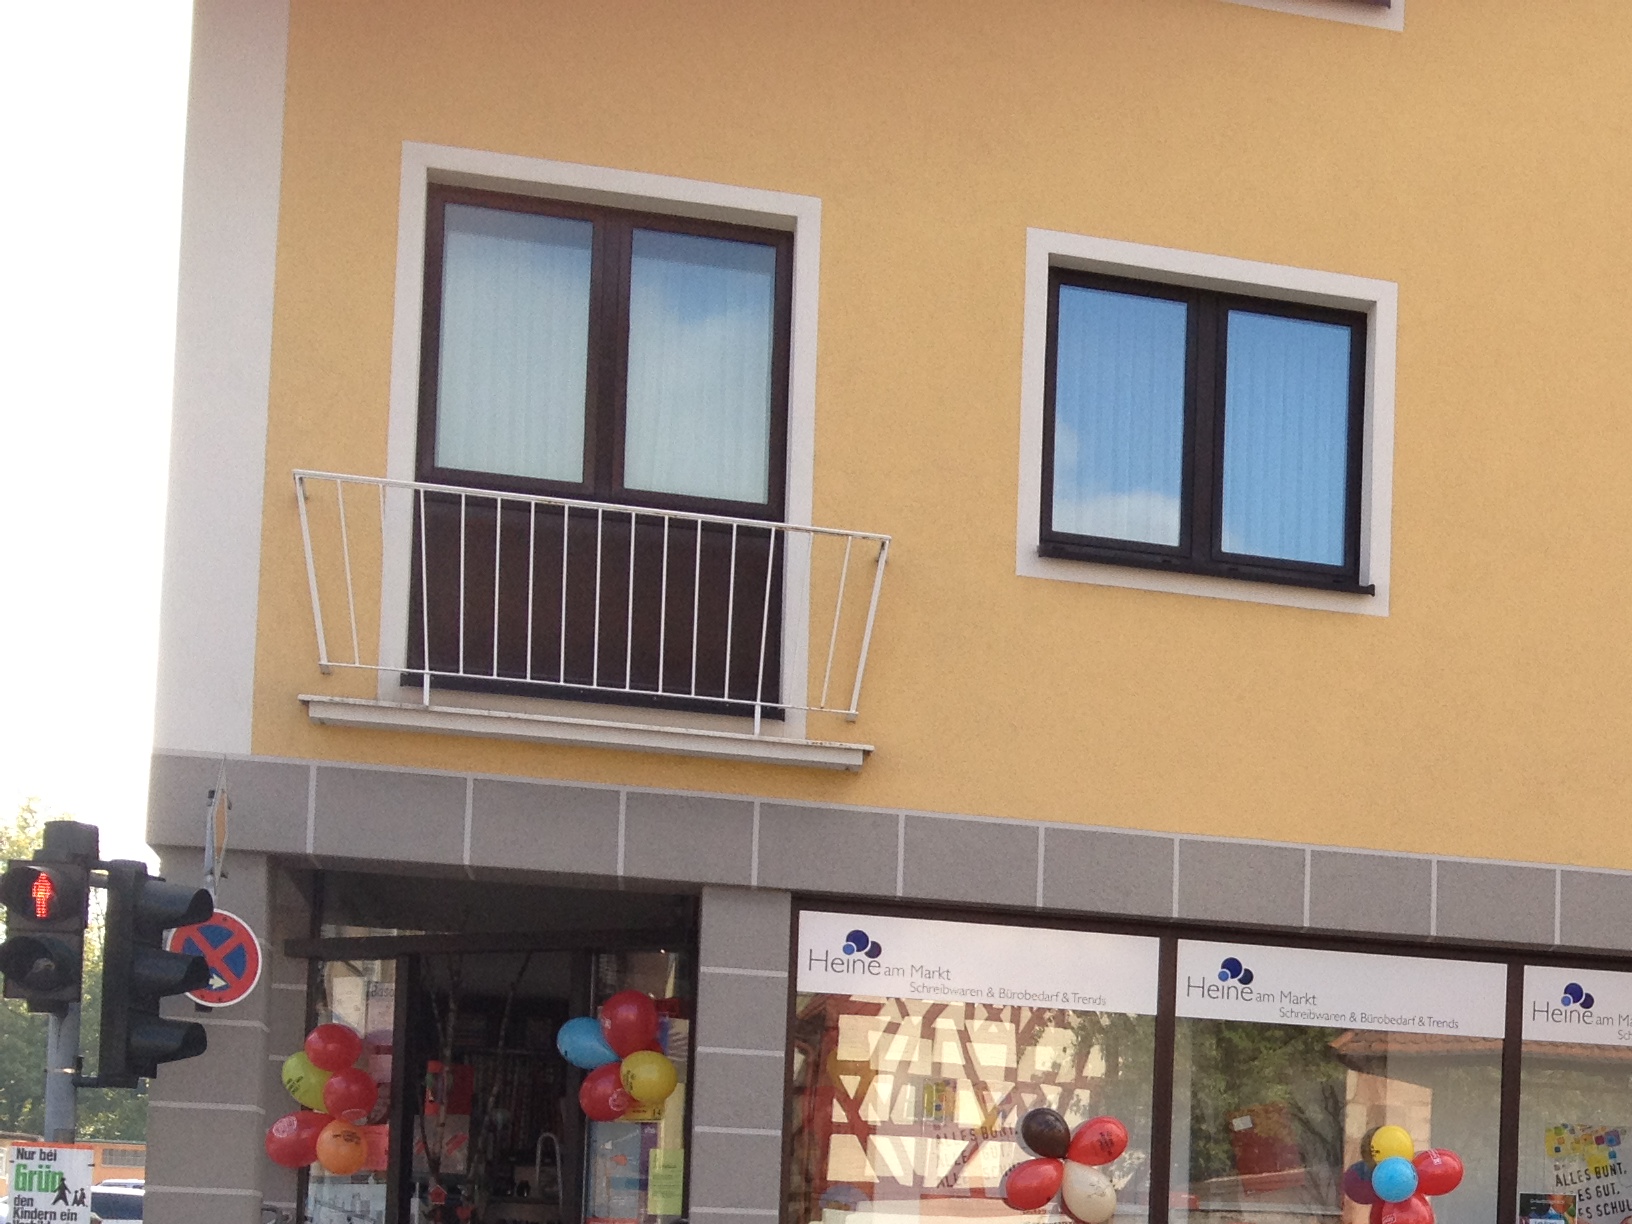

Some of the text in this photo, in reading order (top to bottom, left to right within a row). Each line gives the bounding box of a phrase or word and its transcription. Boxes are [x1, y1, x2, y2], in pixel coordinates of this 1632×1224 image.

[808, 949, 951, 981] Heine am Markt
[910, 982, 983, 998] Schreibwaren
[986, 988, 995, 998] &
[999, 988, 1061, 1003] Bürobedarf
[1071, 993, 1106, 1006] Trends
[1186, 976, 1317, 1006] Heine am Markt
[1279, 1007, 1346, 1022] Schreibwaren
[1349, 1013, 1357, 1023] &
[1360, 1013, 1418, 1027] Bürobedarf
[1427, 1017, 1459, 1029] Trends
[1533, 1001, 1593, 1024] Heine
[1595, 1015, 1614, 1026] am
[16, 1147, 57, 1162] Nur bei
[14, 1163, 64, 1193] Grün
[1555, 1162, 1627, 1187] ALLES BUNT.
[13, 1194, 34, 1207] den
[1595, 1182, 1620, 1198] GUT.
[13, 1207, 78, 1221] Kindern ein
